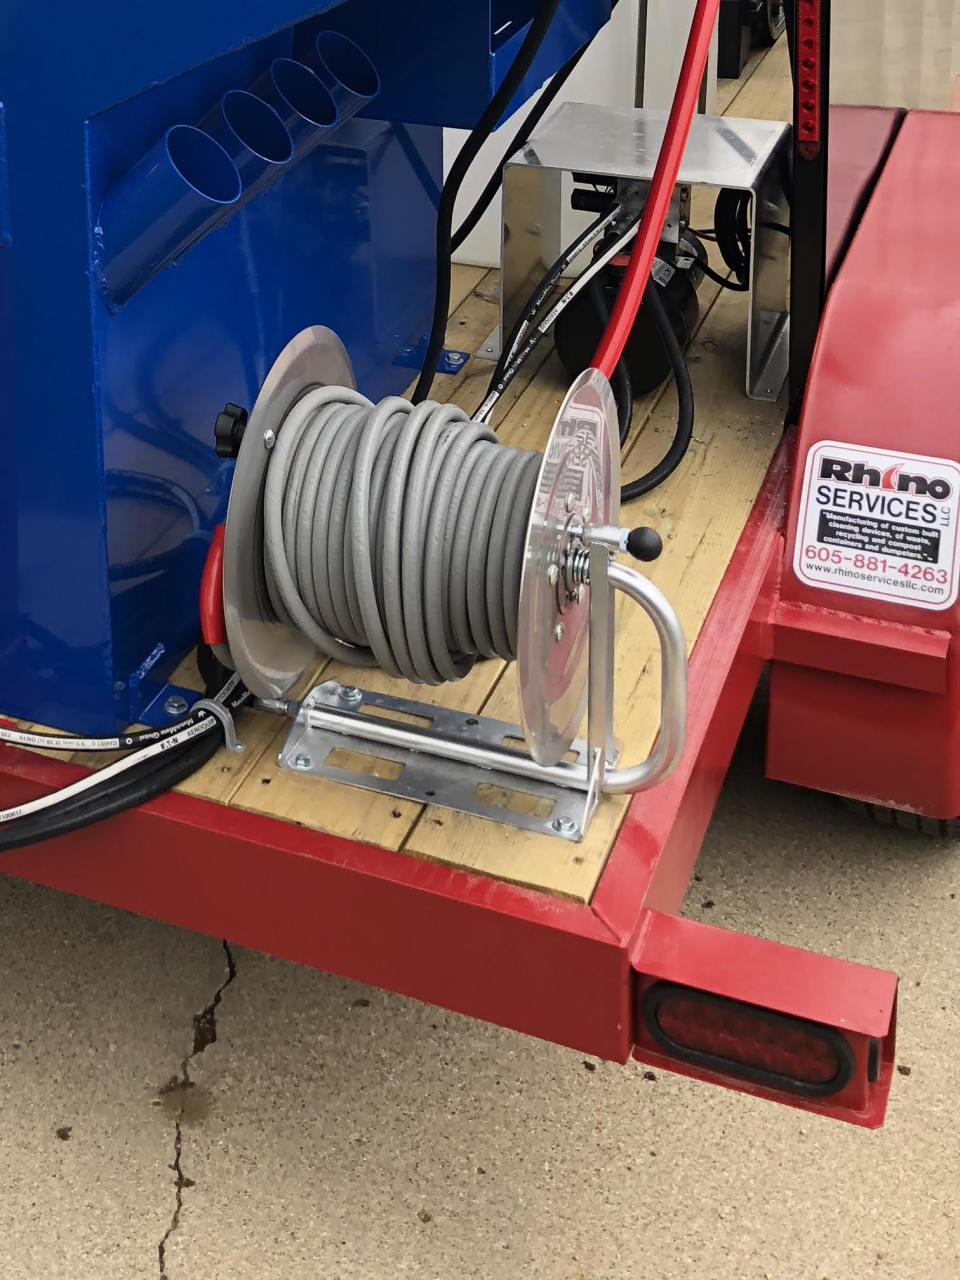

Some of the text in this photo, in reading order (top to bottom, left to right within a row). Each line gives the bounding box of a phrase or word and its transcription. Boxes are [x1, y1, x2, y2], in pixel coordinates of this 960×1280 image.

[818, 456, 952, 501] Rhino
[816, 485, 951, 527] SERVICES LLC
[865, 542, 879, 552] and
[871, 535, 885, 545] and
[805, 545, 948, 585] 605-881-4263
[806, 562, 944, 595] www.rhinoservicesllc.com
